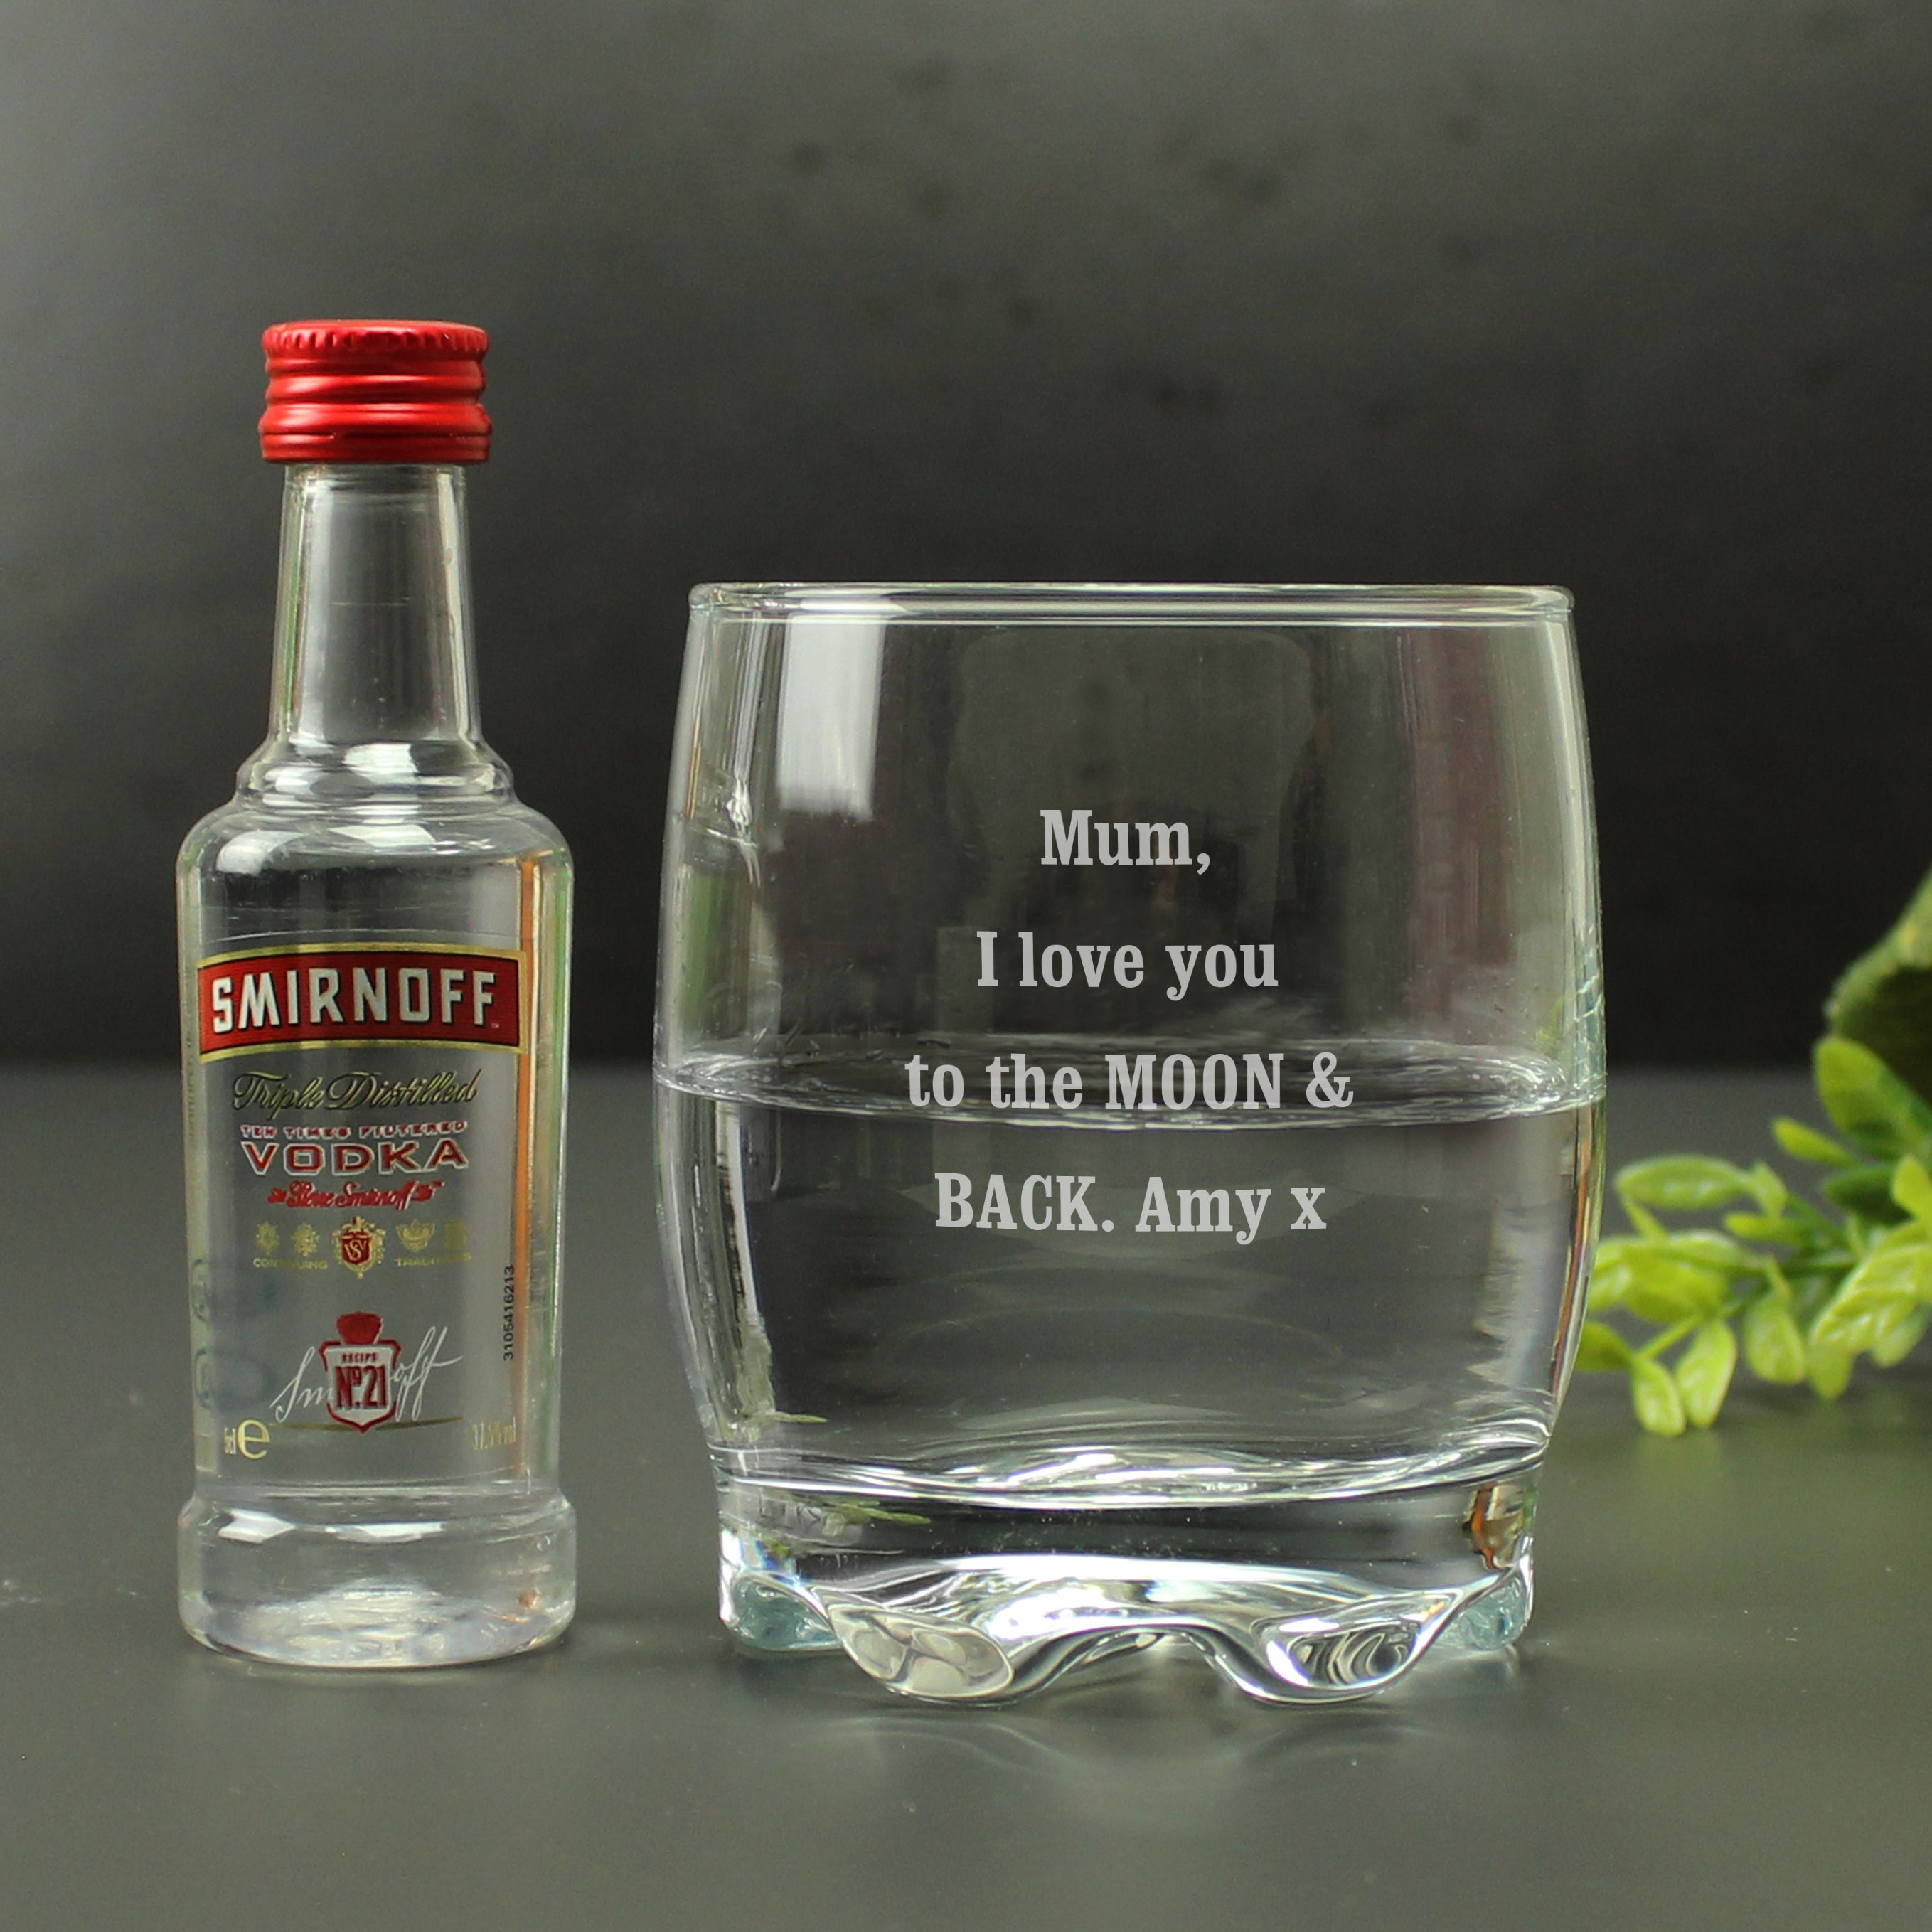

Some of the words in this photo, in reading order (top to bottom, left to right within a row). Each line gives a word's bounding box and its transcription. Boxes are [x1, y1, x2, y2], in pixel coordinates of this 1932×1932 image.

[1040, 809, 1210, 875] Mum,
[976, 931, 998, 986] I
[1018, 932, 1144, 988] love
[1165, 944, 1279, 1001] you
[212, 967, 495, 1034] SMIRNOFF
[233, 1069, 325, 1121] Triple
[326, 1067, 484, 1111] Distilled
[904, 1055, 964, 1106] to
[986, 1053, 1082, 1109] the
[1104, 1052, 1284, 1110] MOON
[1306, 1052, 1354, 1108] &
[240, 1138, 469, 1175] VODKA
[934, 1172, 1114, 1232] BACK.
[1135, 1176, 1271, 1245] Amy
[1290, 1186, 1327, 1230] x
[503, 1264, 516, 1362] 3105416213
